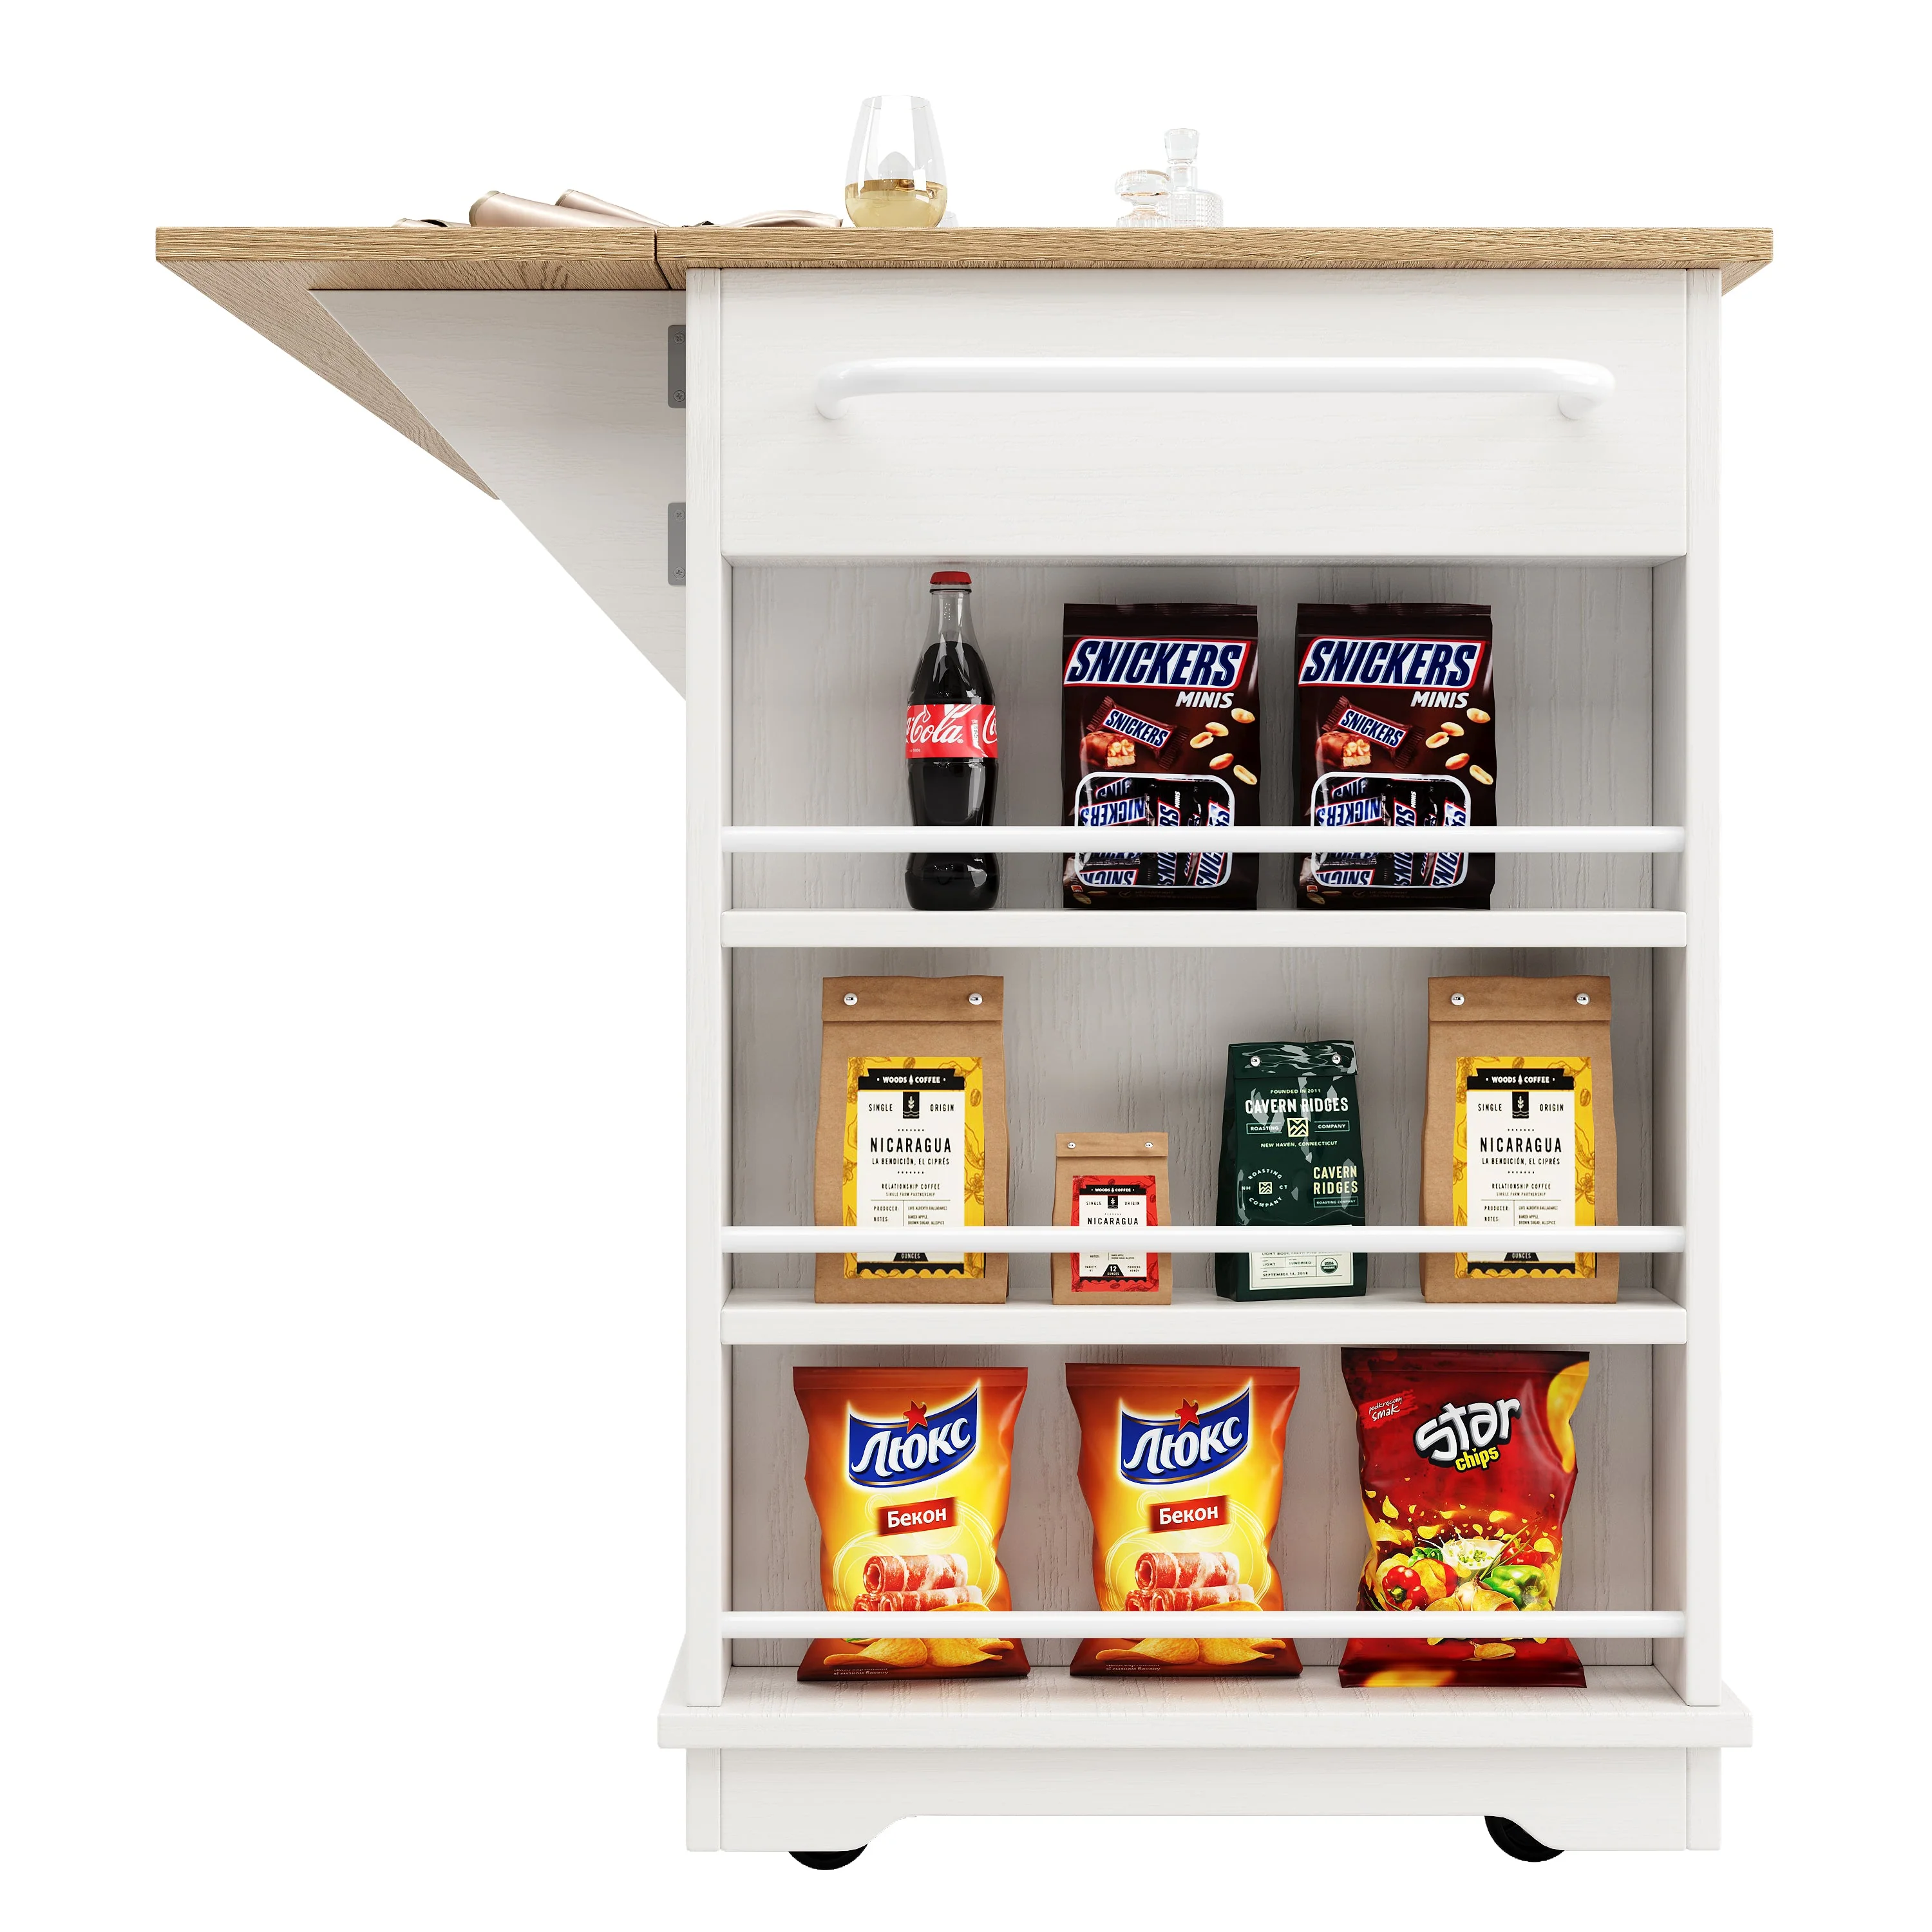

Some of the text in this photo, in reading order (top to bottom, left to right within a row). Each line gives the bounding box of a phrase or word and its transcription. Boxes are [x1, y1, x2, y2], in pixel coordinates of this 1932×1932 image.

[1066, 640, 1243, 687] SNICKERS
[1302, 640, 1477, 687] SNICKERS
[1175, 691, 1233, 708] MINIS
[1410, 691, 1469, 708] MINIS
[1105, 710, 1168, 746] SNICKERS
[1341, 710, 1404, 746] SNICKERS
[1080, 797, 1146, 826] NICKERS
[1316, 797, 1381, 826] NICKERS
[1245, 1097, 1349, 1113] CAVERN RIDGES
[871, 1137, 951, 1152] NICARAGUA
[1481, 1137, 1562, 1152] NICARAGUA
[881, 1157, 916, 1166] BENDICIÓN,
[1492, 1157, 1526, 1166] BENDICIÓN,
[1248, 1168, 1282, 1180] ROASTING
[1313, 1166, 1357, 1179] CAVERN
[1313, 1180, 1358, 1195] RIDGES
[1249, 1197, 1282, 1208] COMPANY
[1372, 1404, 1400, 1421] smak
[851, 1417, 971, 1477] Люкс
[1123, 1416, 1242, 1474] Люкс
[1455, 1446, 1499, 1471] chips
[887, 1507, 947, 1528] Бекон
[1159, 1506, 1218, 1525] Бекон
